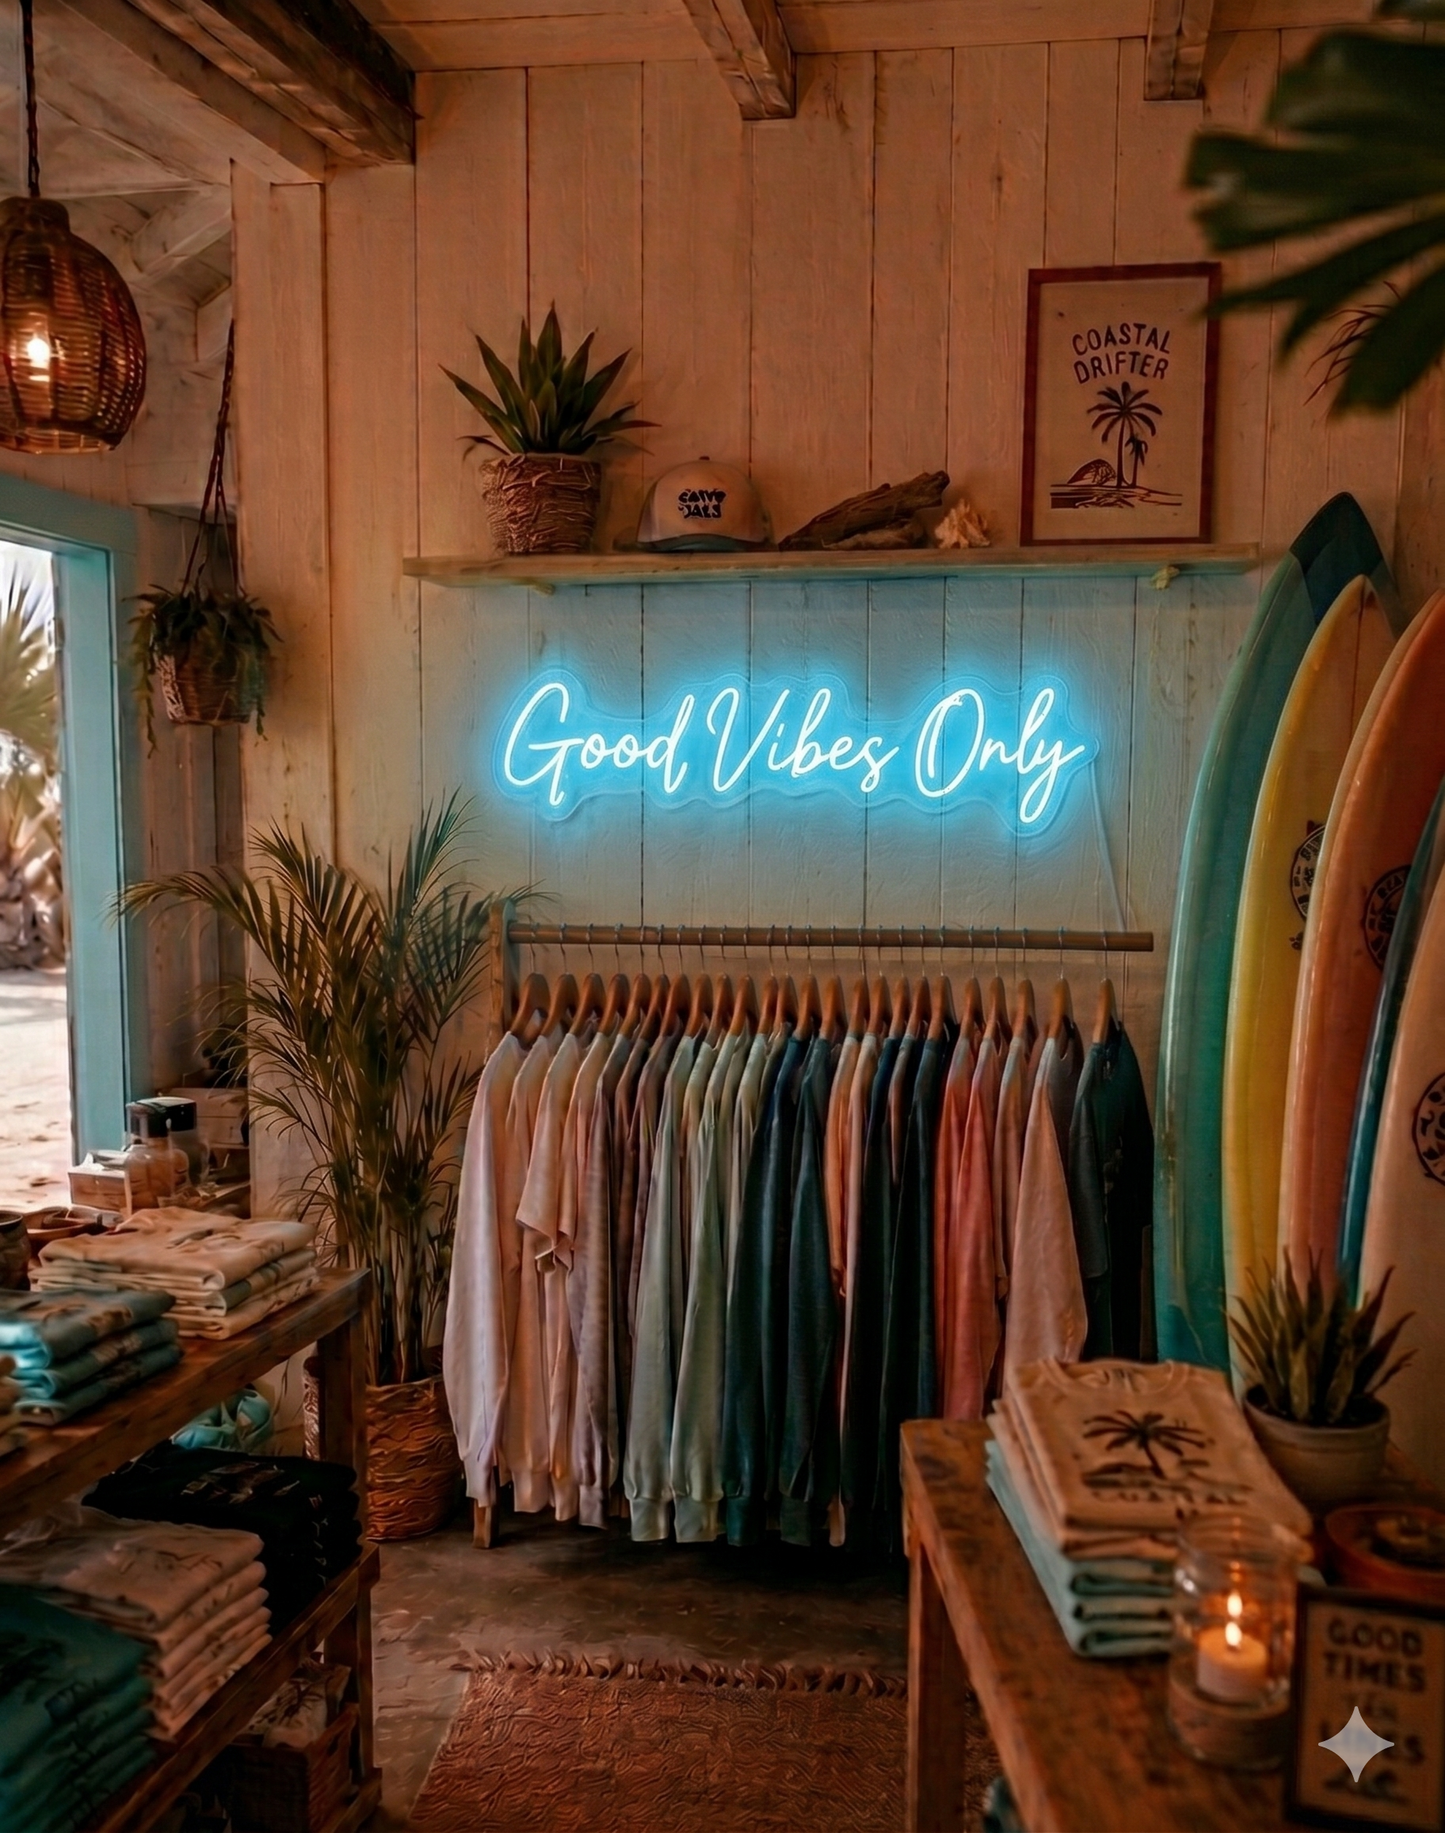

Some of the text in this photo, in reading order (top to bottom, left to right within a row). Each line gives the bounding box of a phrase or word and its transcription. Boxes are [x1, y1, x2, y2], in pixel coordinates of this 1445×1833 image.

[1072, 323, 1170, 355] COASTAL
[1073, 351, 1169, 384] DRIFTER
[503, 682, 1085, 823] Good Vibes Only
[1328, 1617, 1422, 1658] GOOD
[1323, 1651, 1425, 1693] TIMES
